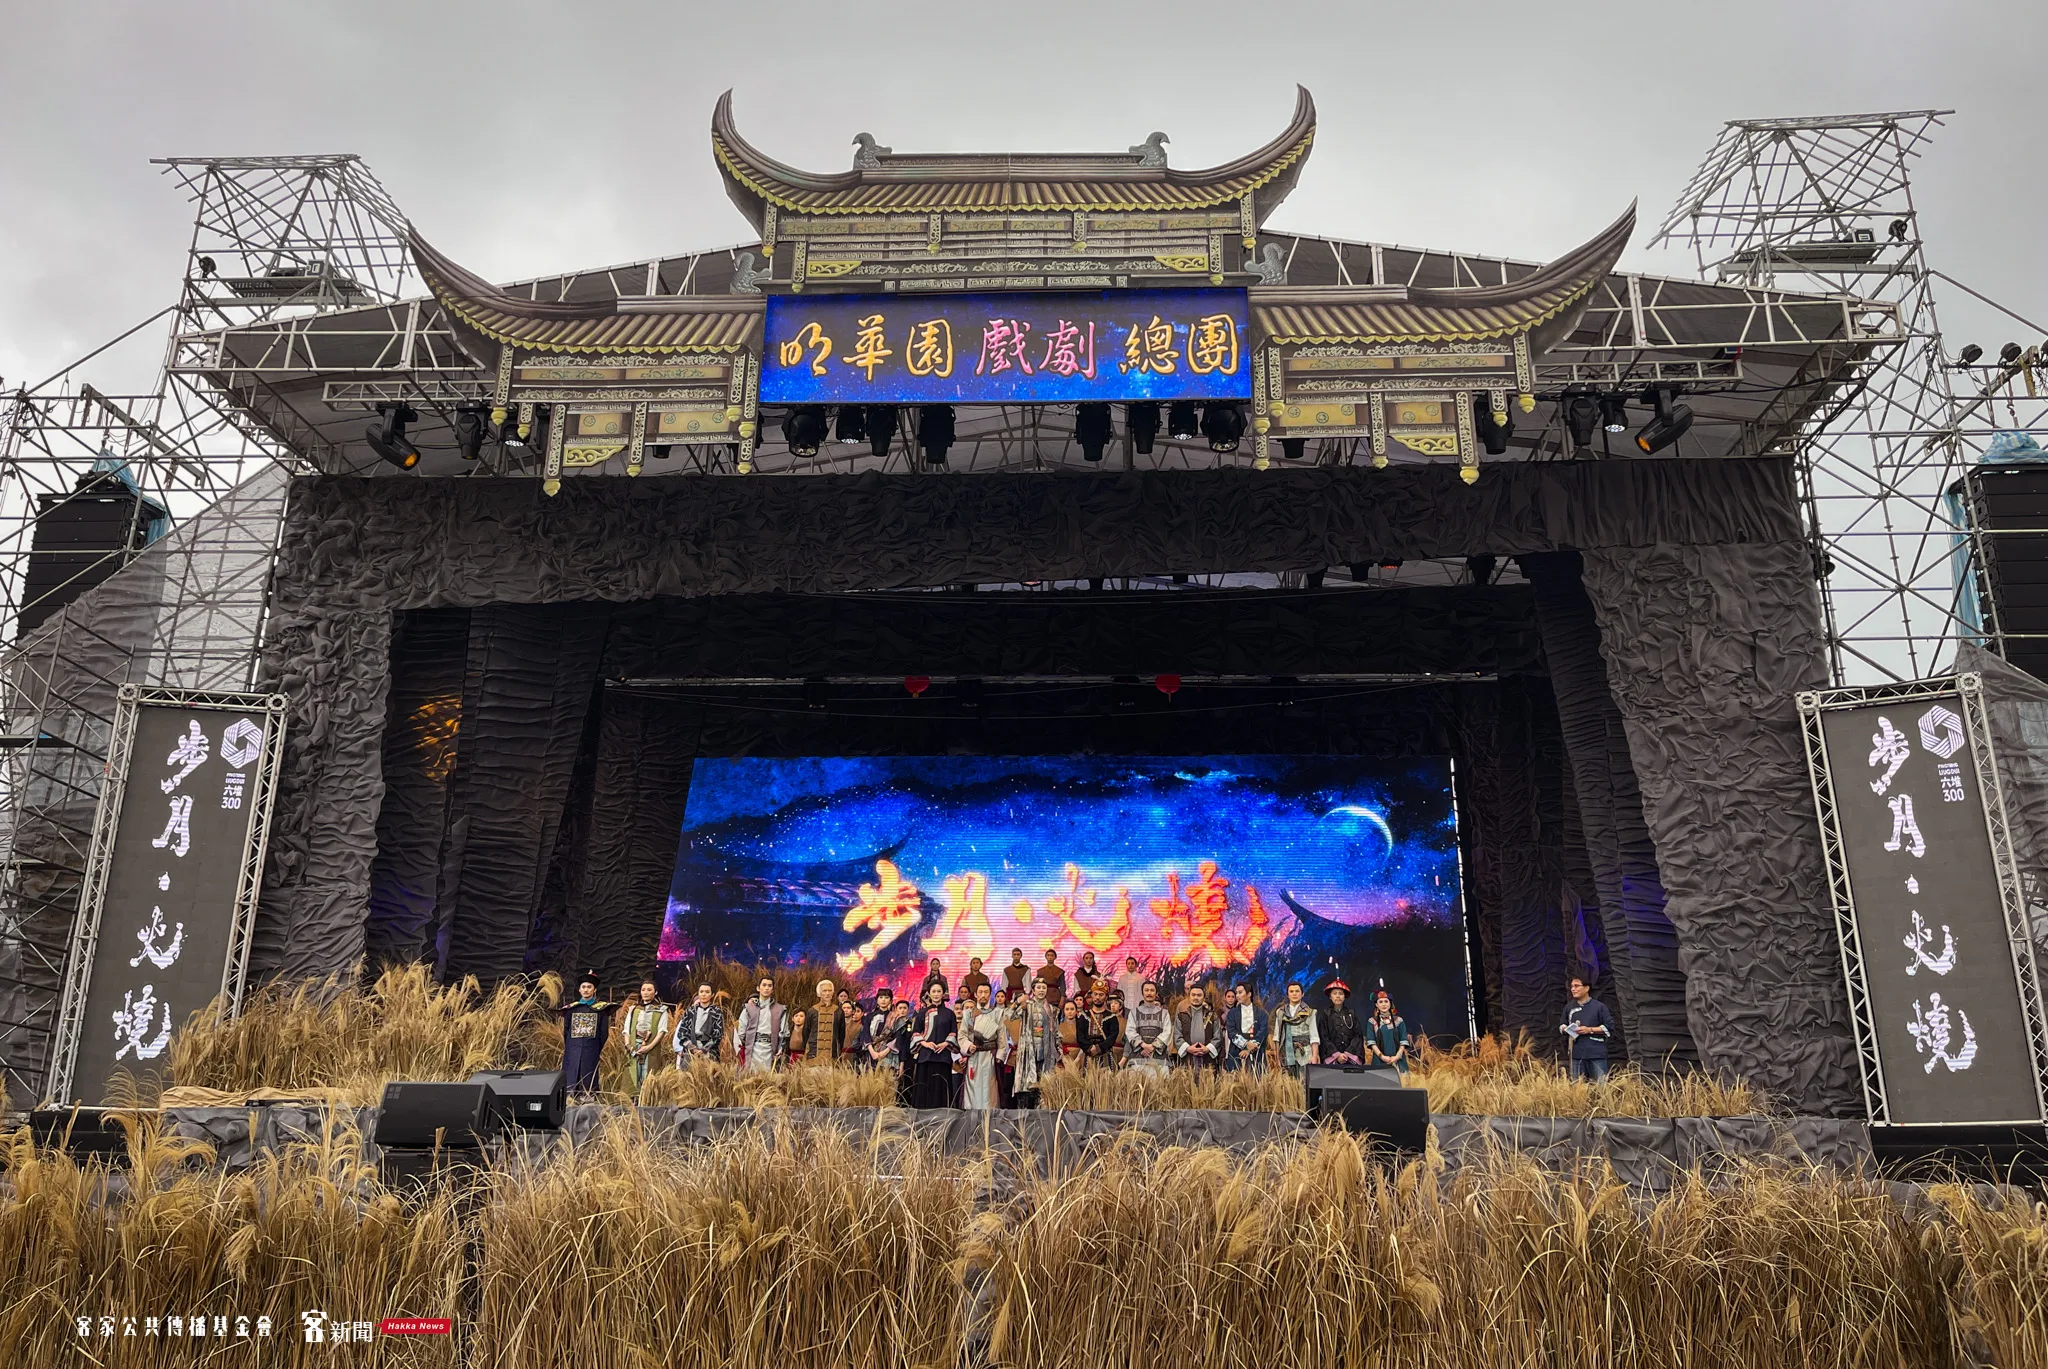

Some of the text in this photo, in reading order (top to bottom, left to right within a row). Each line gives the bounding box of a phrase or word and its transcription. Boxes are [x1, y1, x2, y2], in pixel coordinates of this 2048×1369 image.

[1940, 776, 1962, 788] 六堆
[223, 785, 243, 796] 六堆
[1942, 788, 1964, 802] 300
[221, 797, 241, 809] 300
